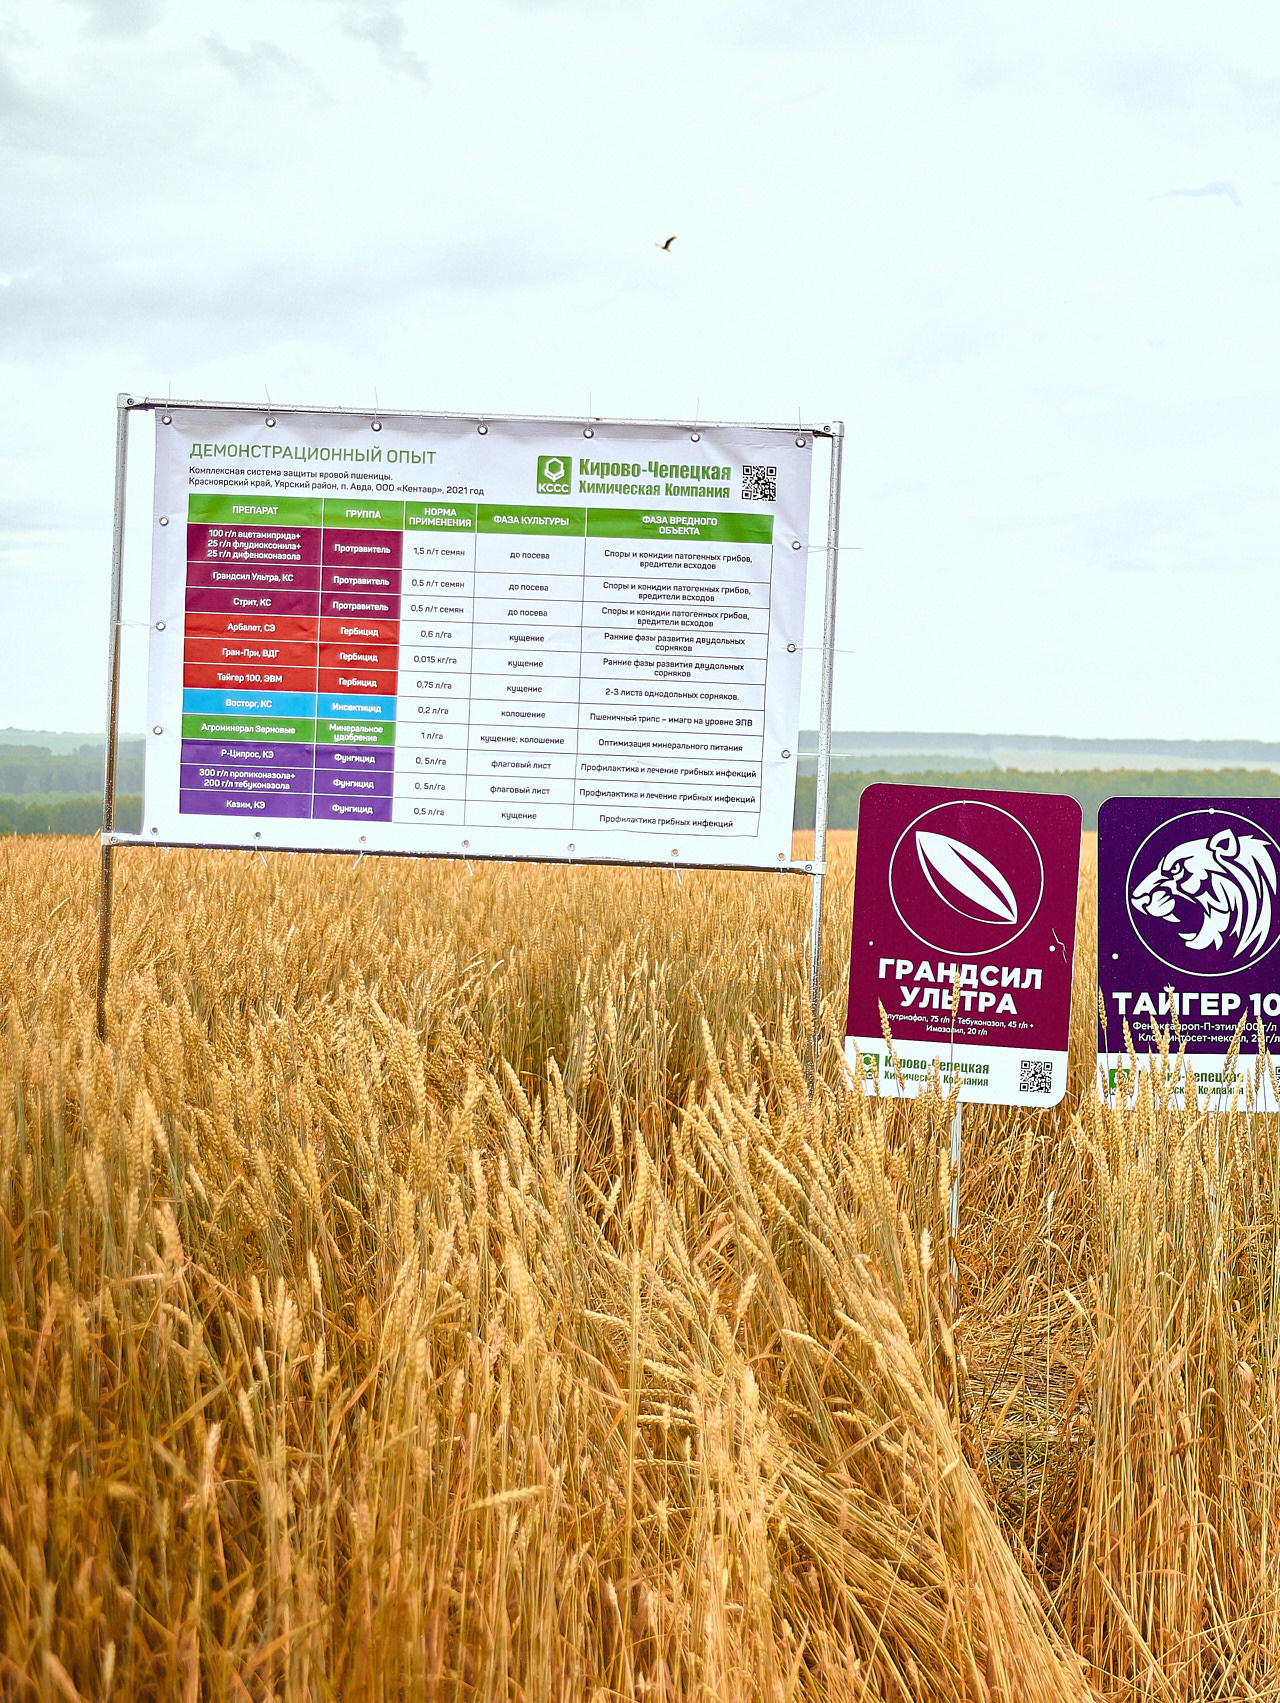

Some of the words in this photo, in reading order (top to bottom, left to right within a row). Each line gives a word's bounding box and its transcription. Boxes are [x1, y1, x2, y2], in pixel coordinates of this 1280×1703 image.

[189, 442, 381, 462] ДЕМОНСТРАЦИОННЫЙ
[386, 449, 436, 464] ОПЫТ
[188, 465, 245, 475] Комплексная
[282, 470, 317, 478] защиты
[318, 470, 349, 480] яровой
[350, 472, 393, 481] пшеницы.
[579, 458, 731, 481] Кирово-Чепецкая
[188, 476, 248, 487] Красноярский
[250, 478, 272, 488] край,
[273, 479, 310, 489] Уярский
[311, 481, 339, 490] район,
[349, 482, 373, 491] Авда,
[375, 483, 394, 491] ООО
[396, 484, 444, 495] «Кентавр»,
[445, 485, 467, 494] 2021
[469, 488, 484, 496] год
[578, 479, 660, 495] Химическая
[664, 482, 730, 498] Компания
[231, 505, 278, 514] ПРЕПАРАТ
[345, 508, 381, 518] ГРУППА
[423, 507, 457, 516] НОРМА
[408, 516, 471, 527] ПРИМЕНЕНИЯ
[493, 514, 520, 524] ФАЗА
[520, 515, 569, 525] КУЛЬТУРЫ
[641, 515, 668, 524] ФАЗА
[668, 516, 718, 526] ВРЕДНОГО
[208, 528, 223, 537] 100
[224, 529, 236, 537] г/л
[658, 525, 700, 535] ОБЪЕКТА
[206, 538, 218, 547] 25
[218, 539, 231, 547] г/л
[333, 543, 391, 554] Протравитель
[413, 546, 425, 554] 1,5
[425, 547, 439, 555] л/т
[206, 549, 217, 557] 25
[218, 549, 231, 558] г/л
[231, 550, 301, 560] дифеноконазола
[509, 551, 520, 559] до
[603, 549, 630, 559] Споры
[722, 554, 752, 563] грибов,
[683, 562, 716, 570] всходов
[212, 571, 250, 580] Грандсил
[251, 571, 281, 583] Ультра,
[281, 573, 294, 581] КС
[226, 622, 262, 632] Арбалет,
[263, 623, 275, 632] СЭ
[339, 626, 379, 637] Гербицид
[603, 632, 633, 640] Ранние
[634, 633, 656, 642] фазы
[657, 635, 694, 643] развития
[695, 637, 745, 645] двудольных
[654, 644, 692, 652] сорняков
[216, 672, 244, 683] Тайгер
[244, 673, 262, 683] 100,
[263, 674, 282, 682] ЭВМ
[416, 680, 433, 689] 0,75
[434, 681, 452, 689] л/га
[224, 698, 259, 709] Восторг,
[259, 699, 272, 708] КС
[331, 702, 382, 713] Инсектицид
[200, 722, 254, 733] Агроминерал
[254, 724, 296, 734] Зерновые
[328, 722, 383, 734] Минеральное
[333, 731, 377, 742] удобрение
[598, 738, 650, 748] Оптимизация
[651, 741, 708, 750] минерального
[220, 748, 261, 759] Р-Ципрос,
[261, 750, 274, 758] КЭ
[333, 752, 375, 763] Фунгицид
[878, 957, 1042, 989] ГРАНДСИЛ
[899, 985, 1017, 1014] УЛЬТРА
[1111, 986, 1241, 1017] ТАЙГЕР
[886, 1013, 928, 1022] лутриафол,
[930, 1014, 939, 1022] 75
[957, 1016, 1006, 1028] Тебуконазол,
[1007, 1020, 1017, 1028] 45
[966, 1026, 977, 1034] 20
[942, 1074, 989, 1087] Коания
